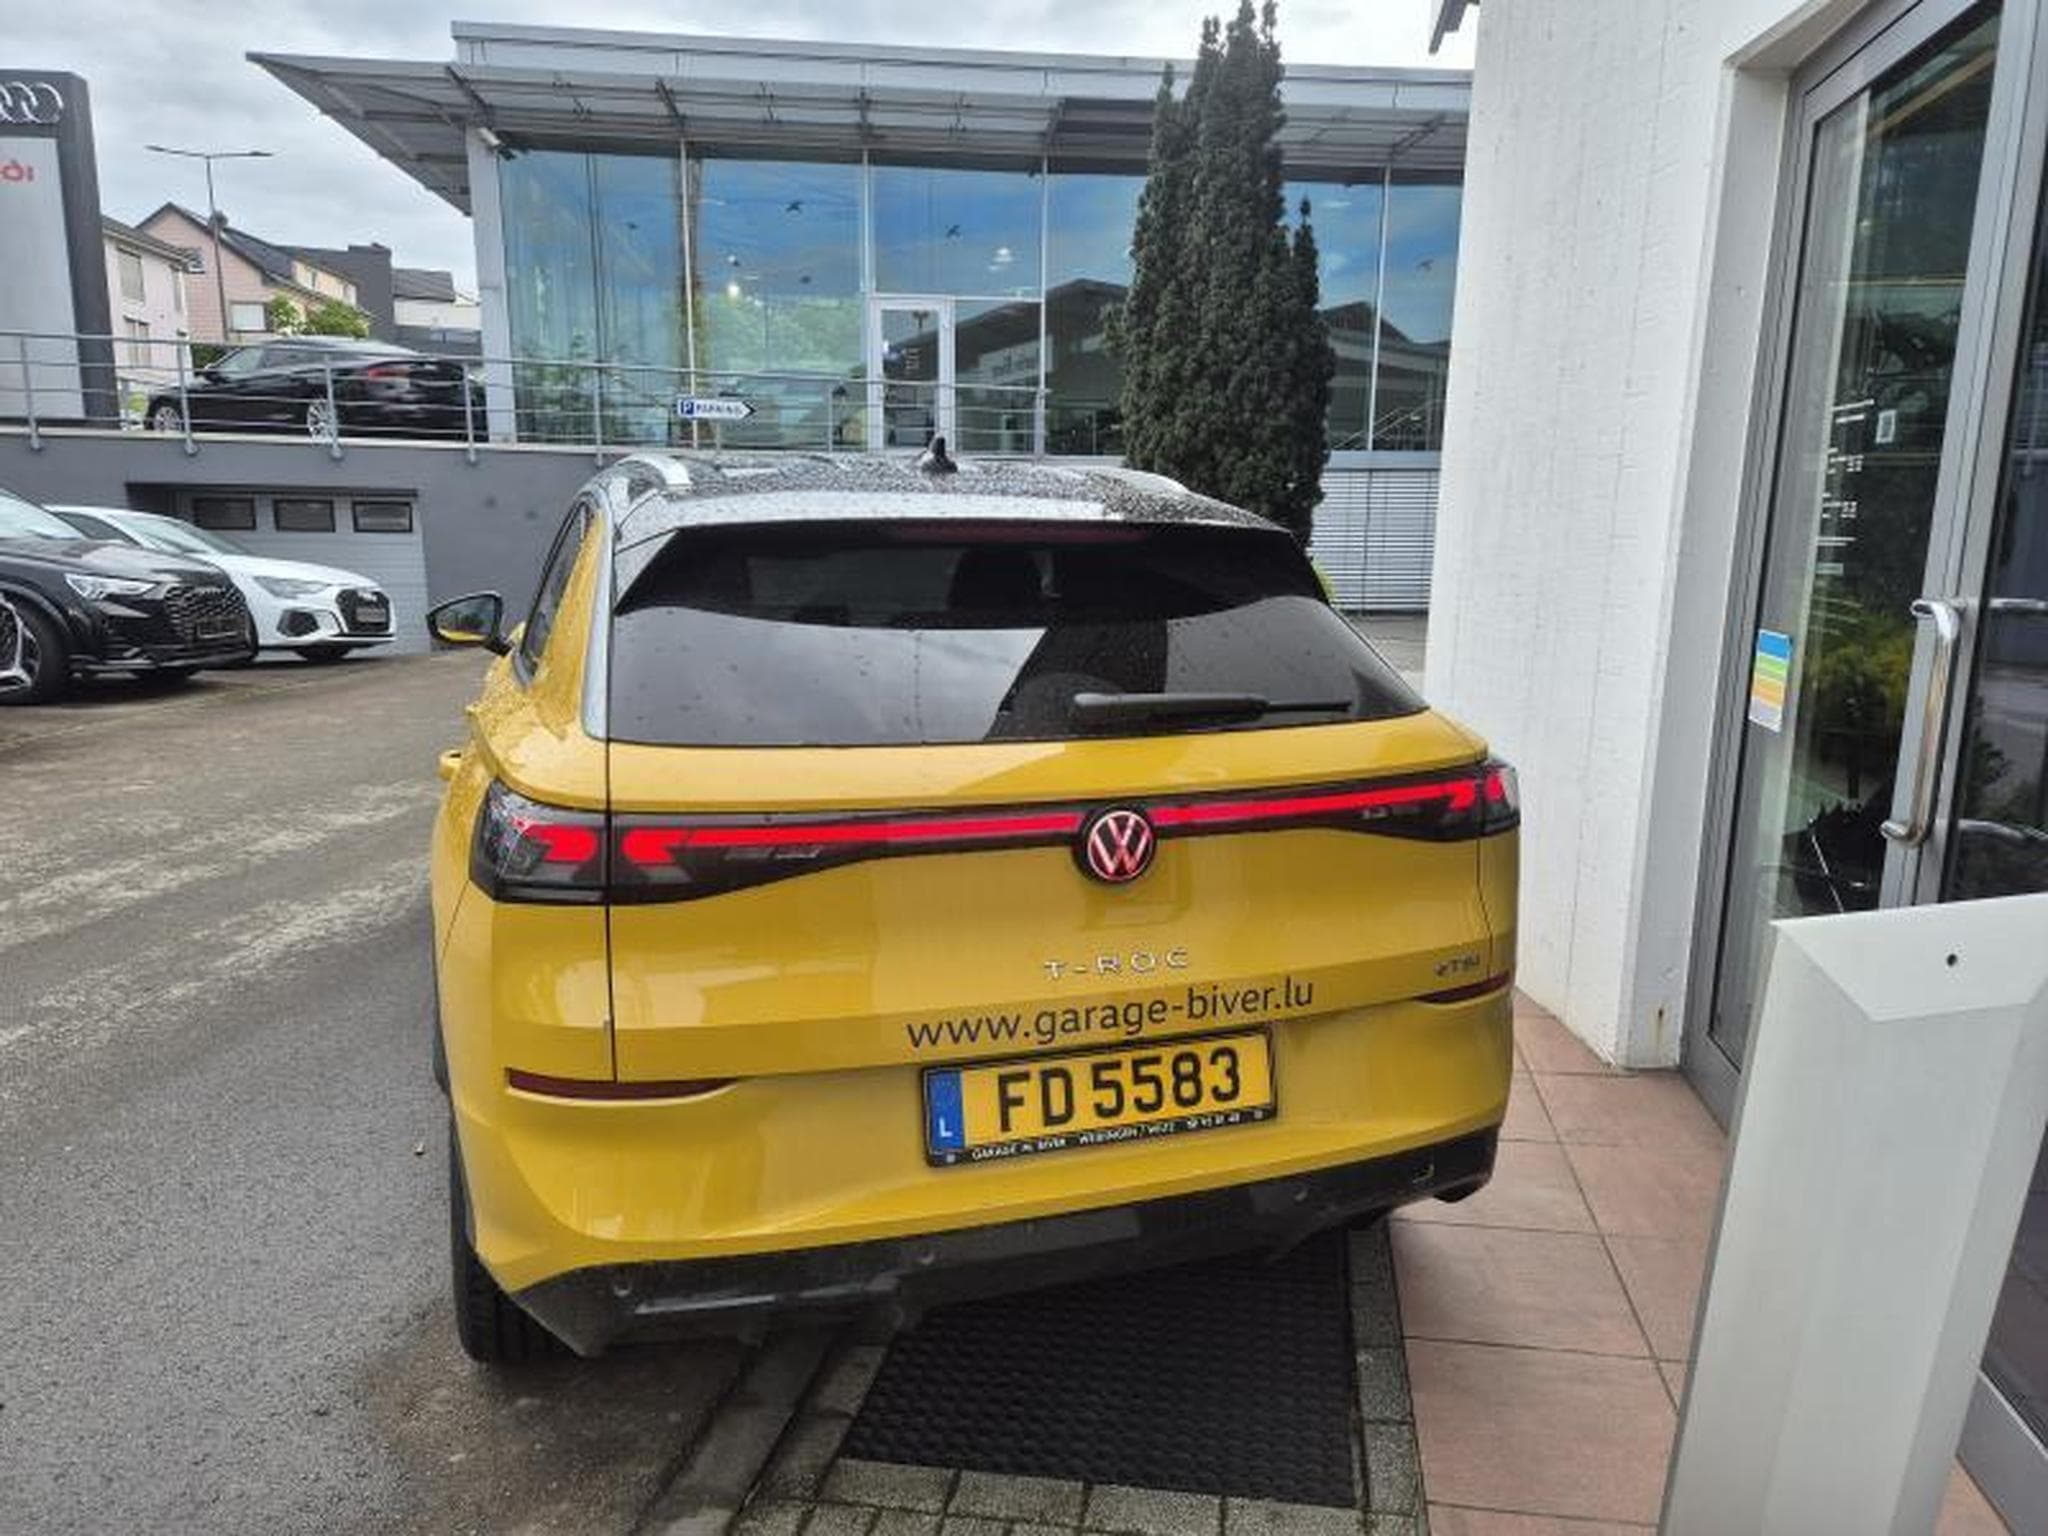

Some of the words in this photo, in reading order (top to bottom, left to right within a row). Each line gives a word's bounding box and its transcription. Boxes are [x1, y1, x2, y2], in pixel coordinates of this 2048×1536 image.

[1044, 947, 1188, 980] T-ROC
[906, 976, 1314, 1049] www.garage-biver.lu
[998, 1067, 1075, 1132] FD
[1090, 1046, 1241, 1119] 5583
[938, 1118, 952, 1138] L
